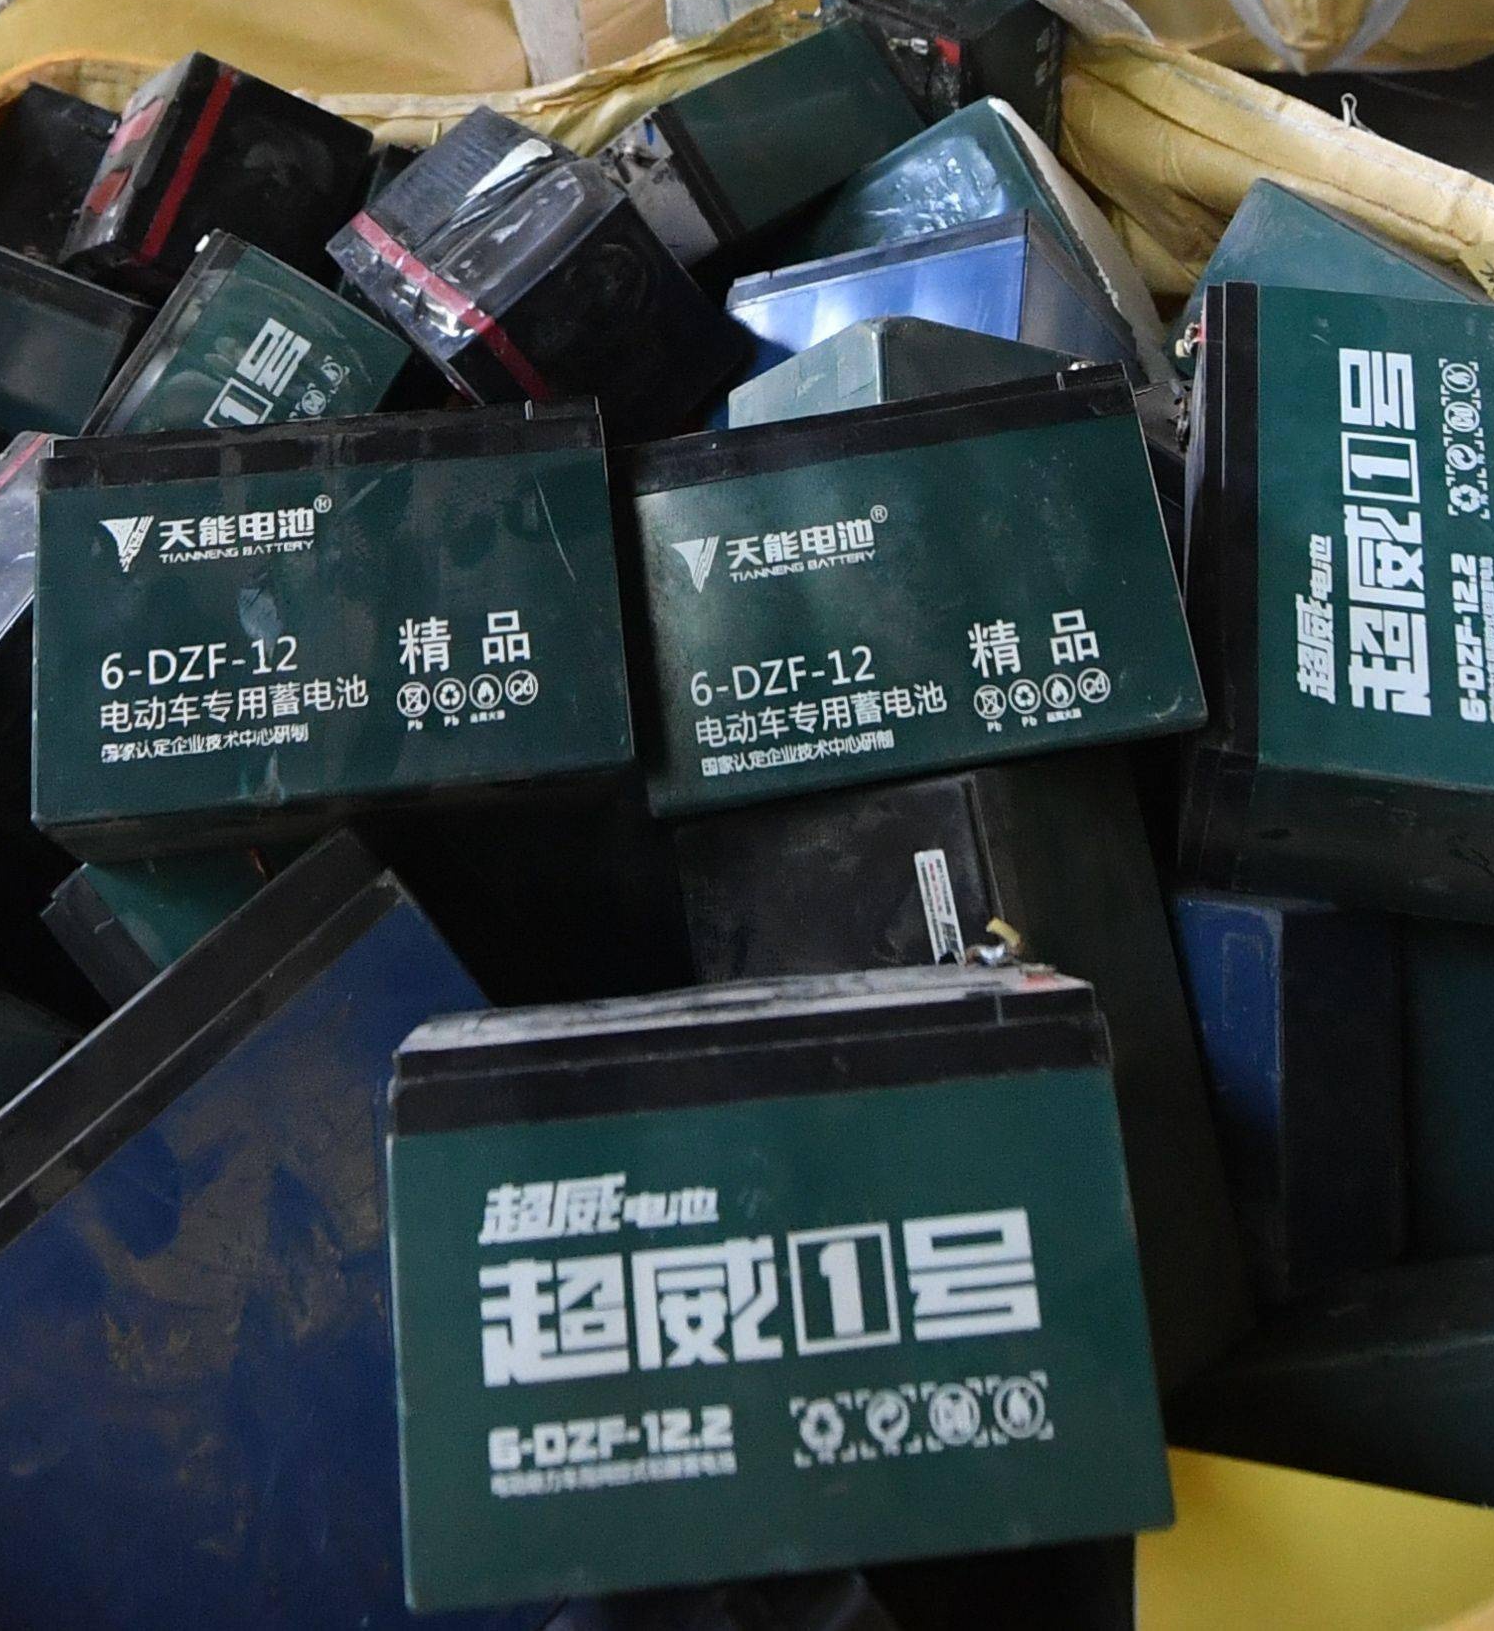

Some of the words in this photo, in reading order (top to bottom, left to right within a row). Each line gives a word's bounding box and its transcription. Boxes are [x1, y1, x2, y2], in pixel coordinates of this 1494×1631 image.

[158, 507, 315, 551] 天能电池
[158, 548, 239, 564] TIANNENG
[243, 540, 315, 557] BATTERY
[725, 518, 875, 570] 天能电池
[729, 561, 805, 583] TIANNENG
[807, 549, 877, 571] BATTERY
[100, 636, 299, 690] 6-DZF-12
[690, 645, 876, 707] 6-DZF-12
[100, 674, 369, 733] 电动车专用蓄电池
[695, 681, 947, 748] 电动车专用蓄电池
[488, 1404, 735, 1471] 6-DZF-12.2
